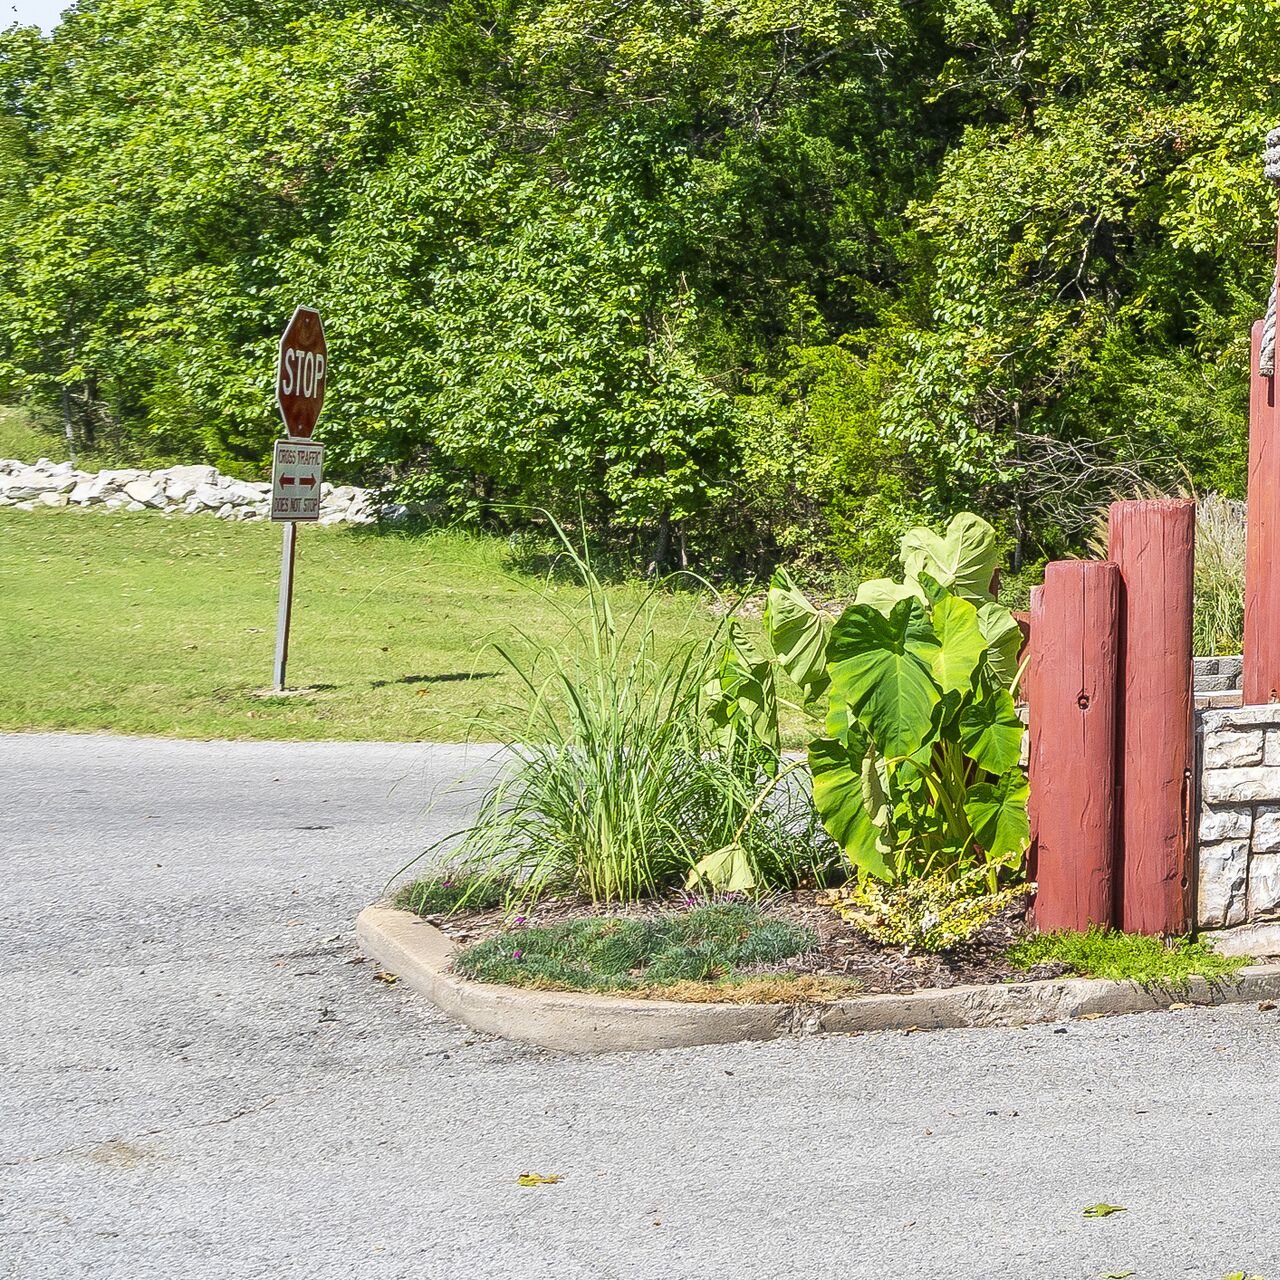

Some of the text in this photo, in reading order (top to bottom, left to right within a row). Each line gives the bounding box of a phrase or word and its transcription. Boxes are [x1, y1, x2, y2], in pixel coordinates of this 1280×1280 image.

[283, 348, 324, 398] STOP
[278, 449, 321, 465] CROSS TRAFFIC
[274, 497, 318, 513] DOES NOT STOP
